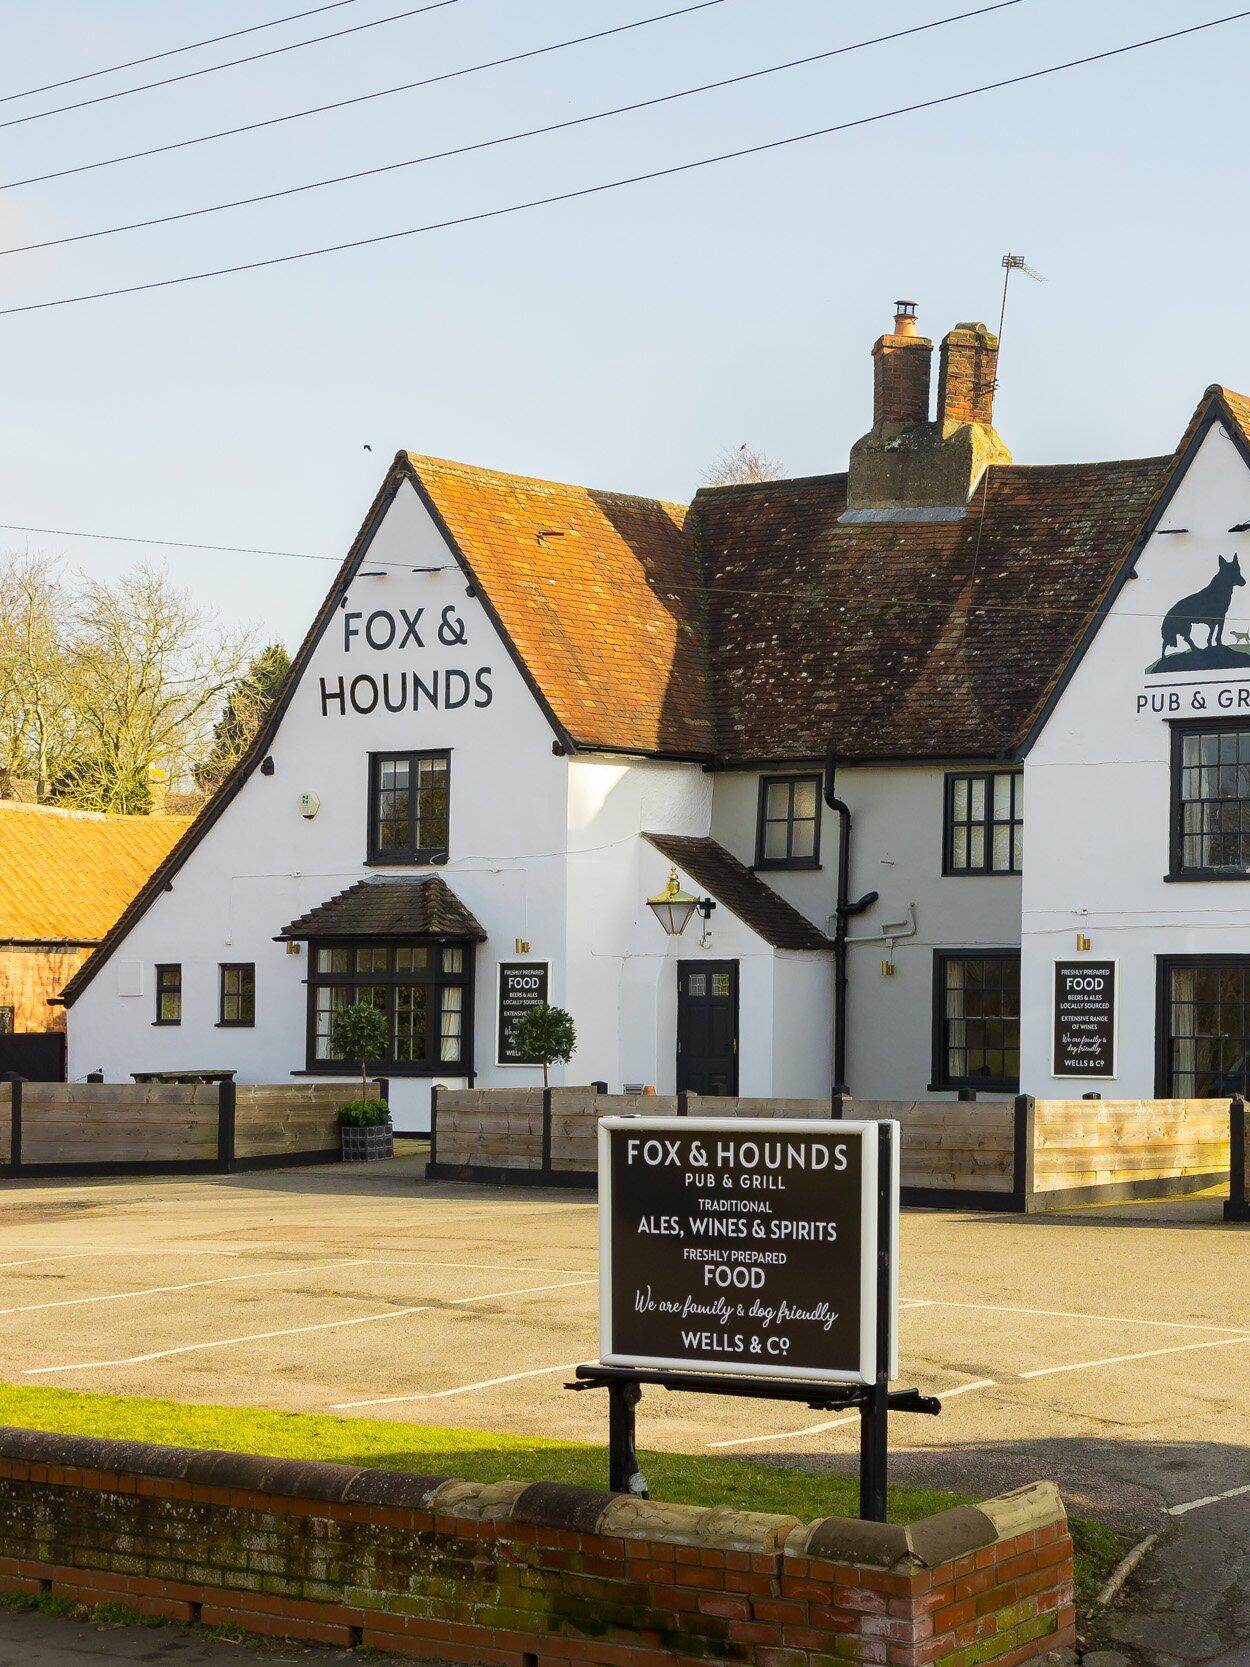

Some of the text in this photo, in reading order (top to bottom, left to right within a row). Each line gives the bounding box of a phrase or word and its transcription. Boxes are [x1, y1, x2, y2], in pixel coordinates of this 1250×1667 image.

[344, 605, 468, 652] FOX &
[319, 666, 493, 717] HOUNDS
[1136, 692, 1181, 714] PUB
[1191, 690, 1207, 710] &
[508, 977, 540, 989] FOOD
[1066, 977, 1104, 990] FOOD
[1064, 1059, 1088, 1067] WELLS
[1089, 1059, 1094, 1067] &
[627, 1139, 848, 1171] FOX & HOUNDS
[685, 1173, 786, 1190] PUB & GRILL
[698, 1199, 772, 1213] TRADITIONAL
[637, 1216, 837, 1242] ALES, WINES & SPIRITS
[683, 1248, 787, 1265] FRESHLY PREPARED
[704, 1265, 766, 1289] FOOD
[634, 1285, 838, 1331] We are family & dog friendly
[681, 1331, 744, 1352] WELLS
[750, 1335, 762, 1353] &
